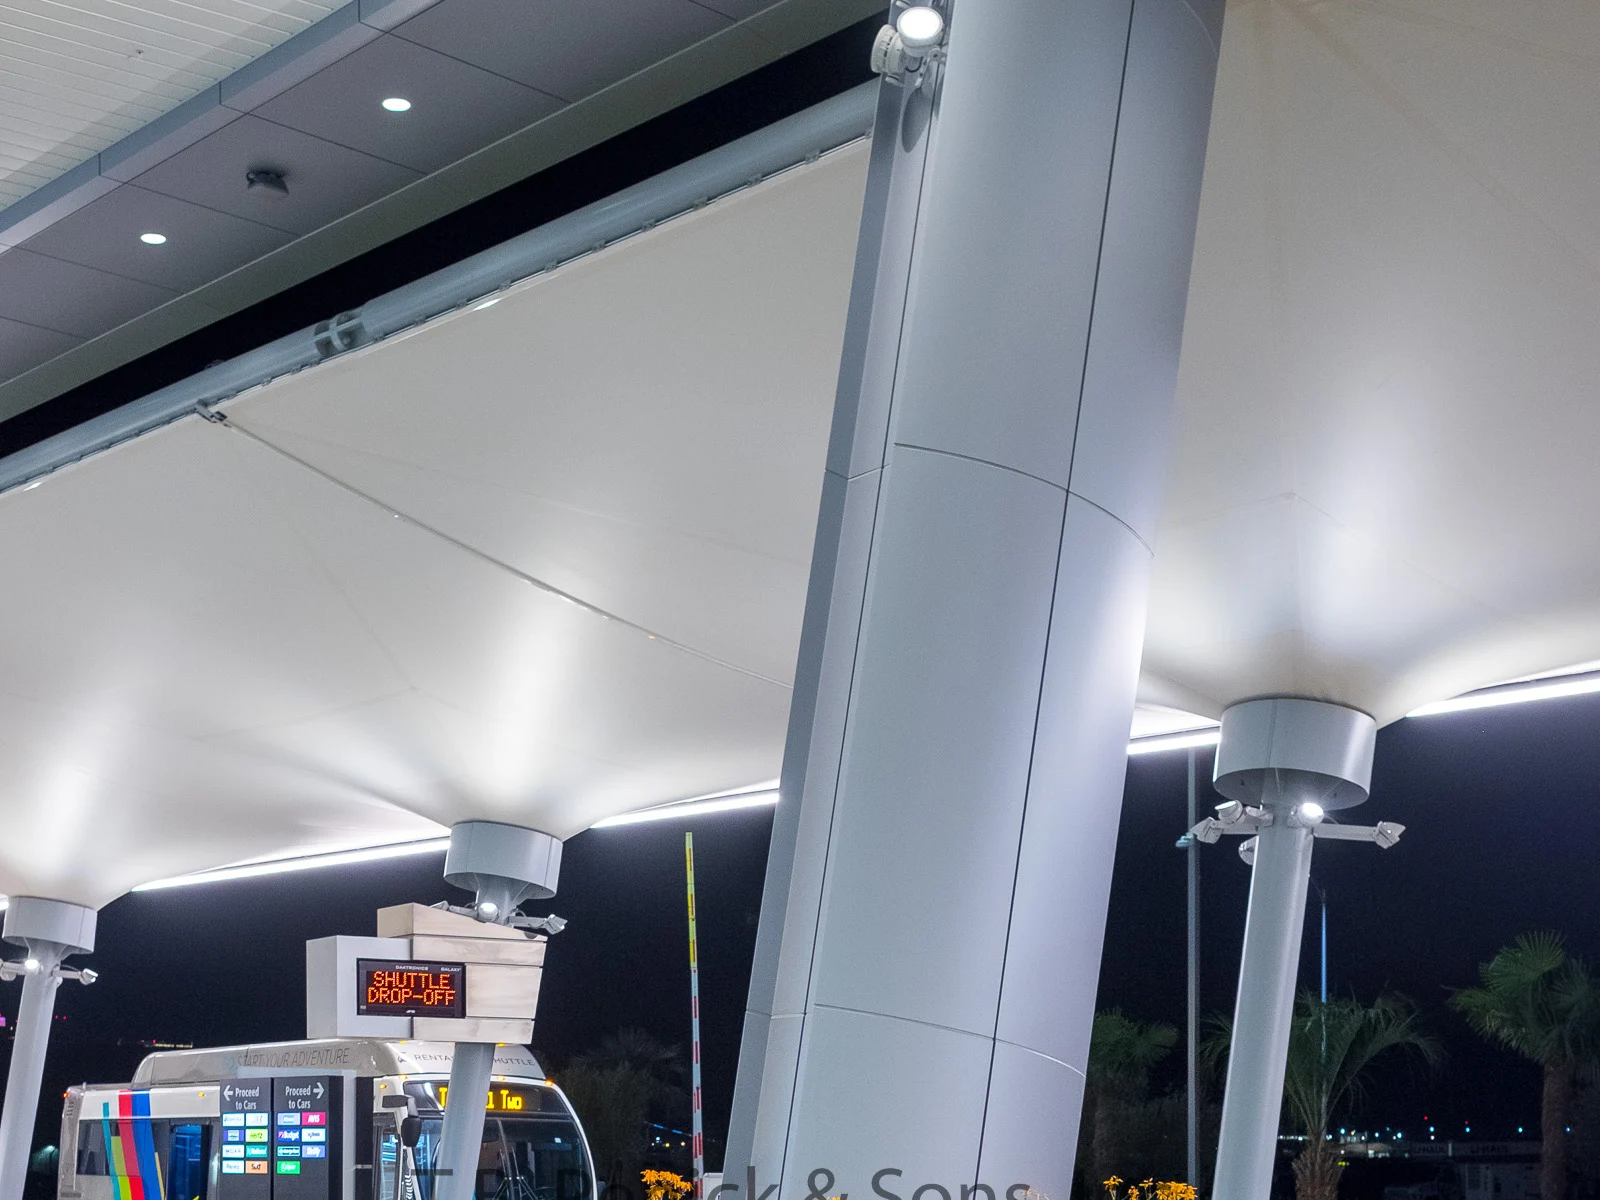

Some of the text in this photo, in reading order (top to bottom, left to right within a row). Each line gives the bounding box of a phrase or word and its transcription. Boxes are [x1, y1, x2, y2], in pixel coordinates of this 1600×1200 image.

[373, 970, 451, 989] SHUTTLE
[367, 986, 457, 1006] DROP-OFF
[266, 1052, 291, 1068] YOUR
[414, 1054, 536, 1067] RENTA HUTTLE
[235, 1086, 260, 1098] Proceed
[285, 1085, 311, 1097] Proceed
[235, 1100, 257, 1110] to Cars
[288, 1099, 311, 1109] to Cars
[500, 1089, 522, 1110] Two
